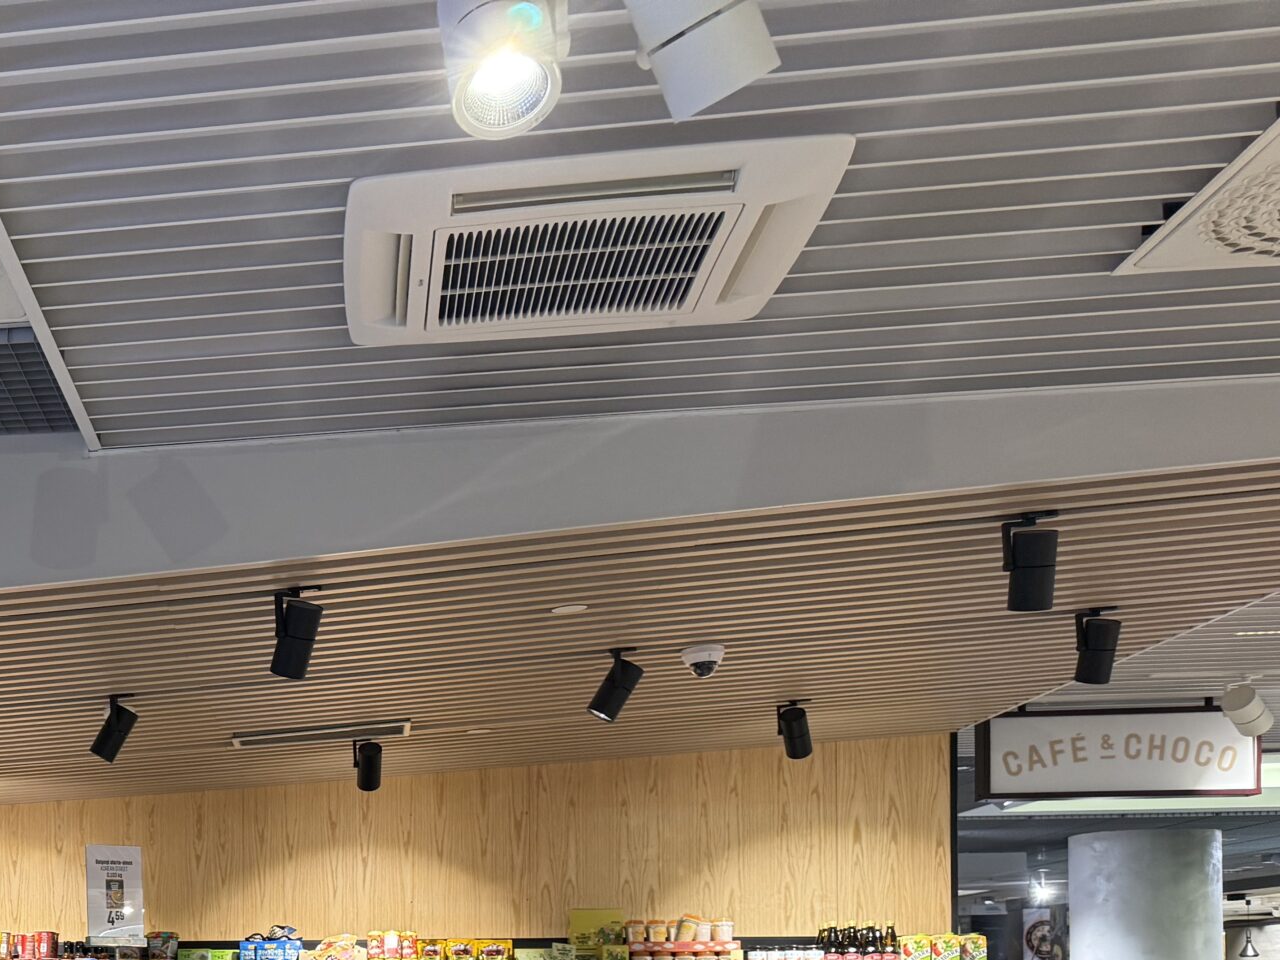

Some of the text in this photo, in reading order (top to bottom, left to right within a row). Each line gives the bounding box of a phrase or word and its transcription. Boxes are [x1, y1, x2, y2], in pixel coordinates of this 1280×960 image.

[1001, 732, 1238, 777] CAFÉ & CHOCO
